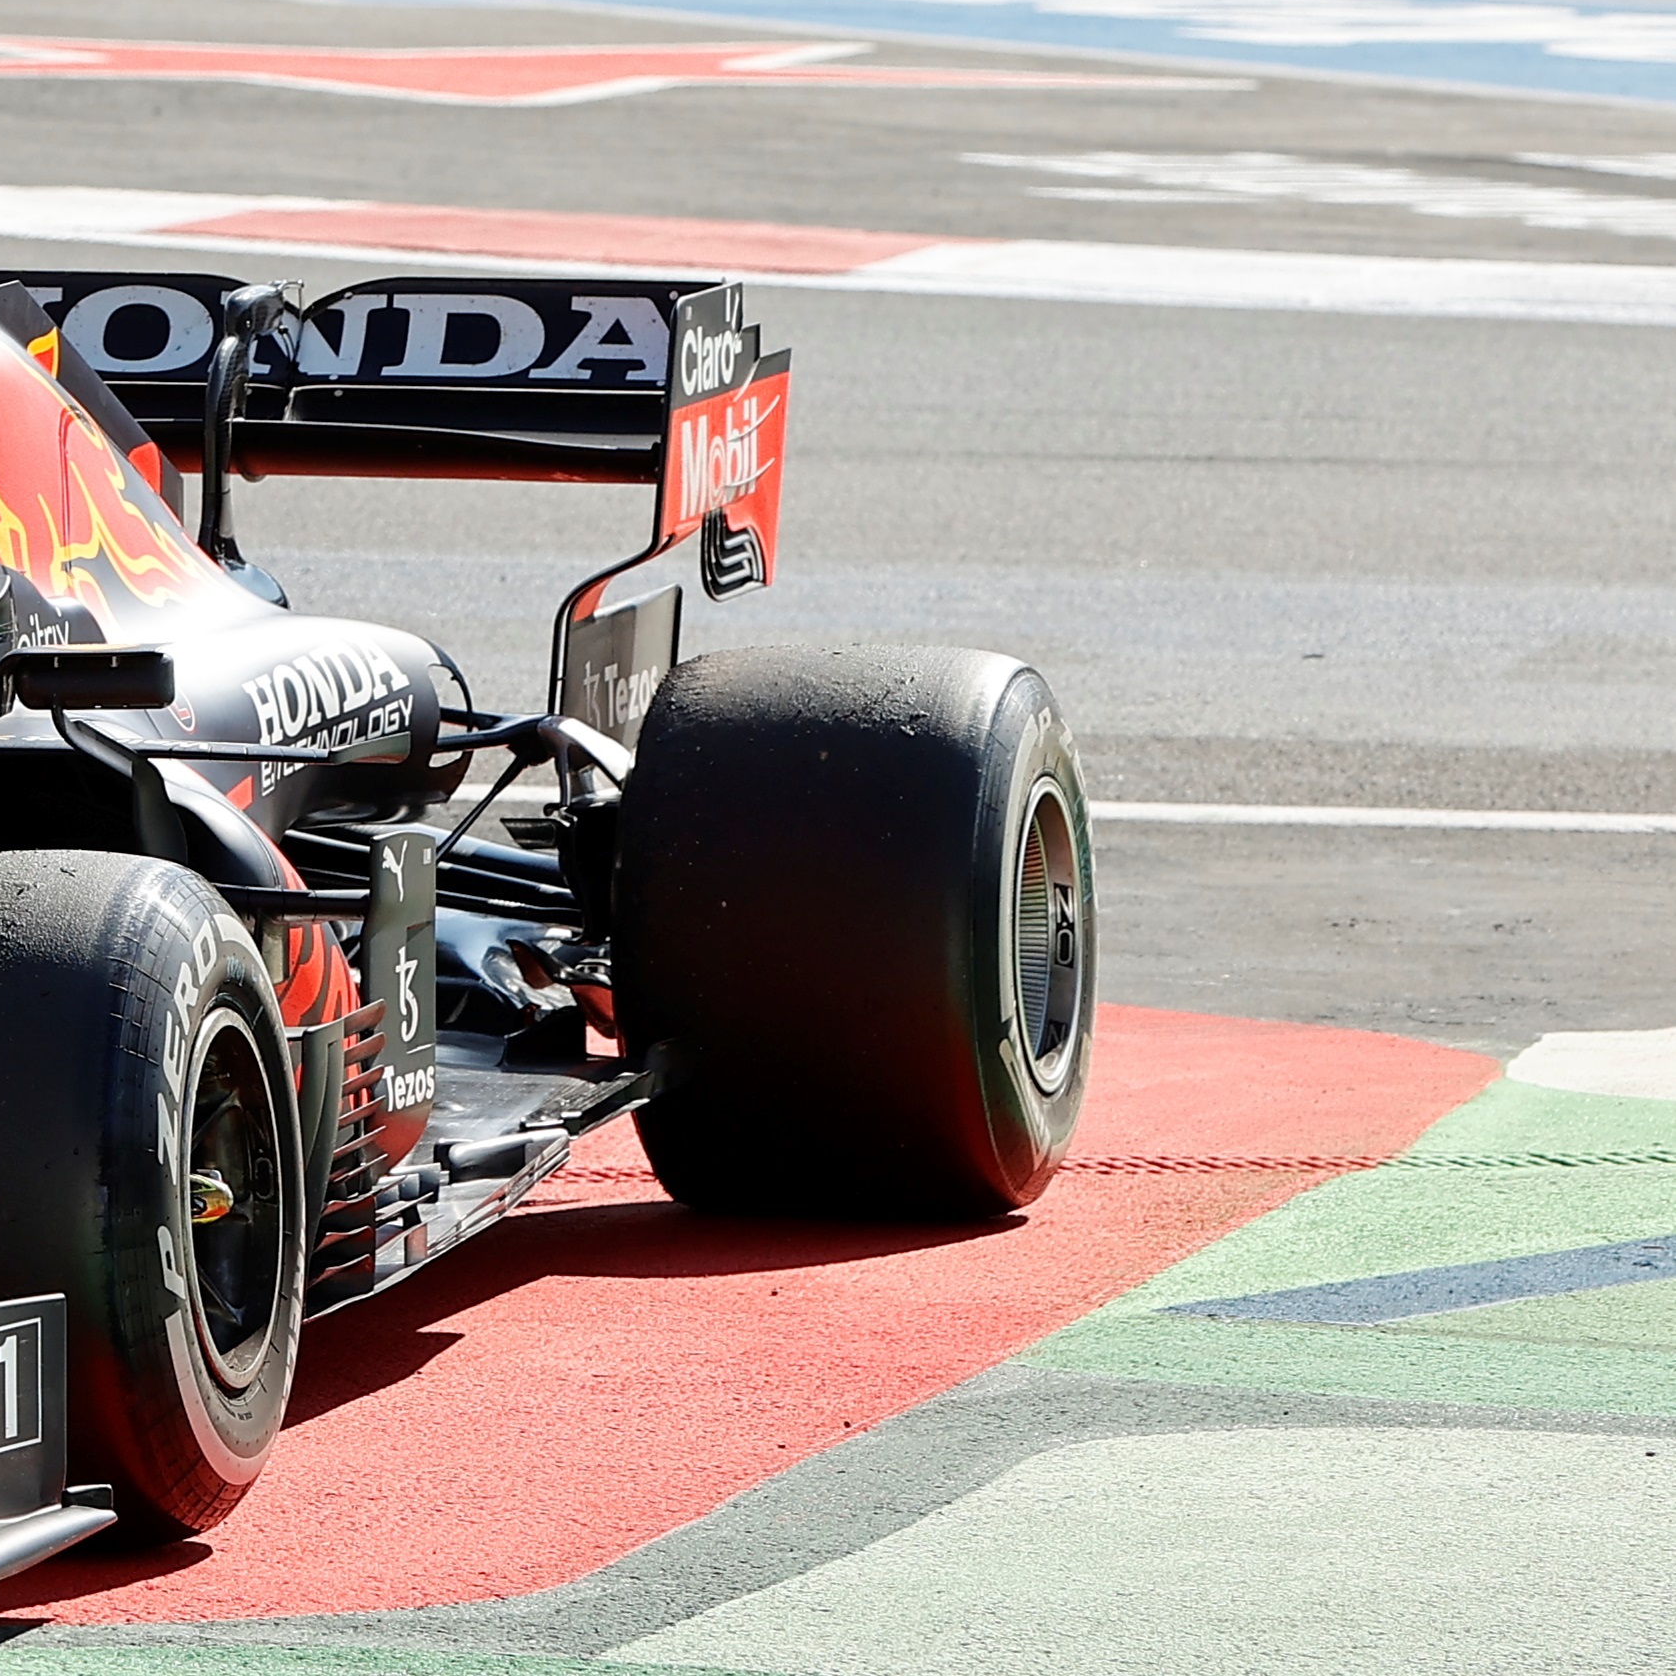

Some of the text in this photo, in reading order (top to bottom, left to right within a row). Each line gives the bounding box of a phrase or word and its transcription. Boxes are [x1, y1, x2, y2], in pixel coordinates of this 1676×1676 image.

[679, 324, 735, 397] Claro
[679, 394, 759, 522] Mobil
[241, 634, 412, 747] HONDA
[155, 917, 219, 1187] ZERO
[382, 1064, 436, 1113] Tezos
